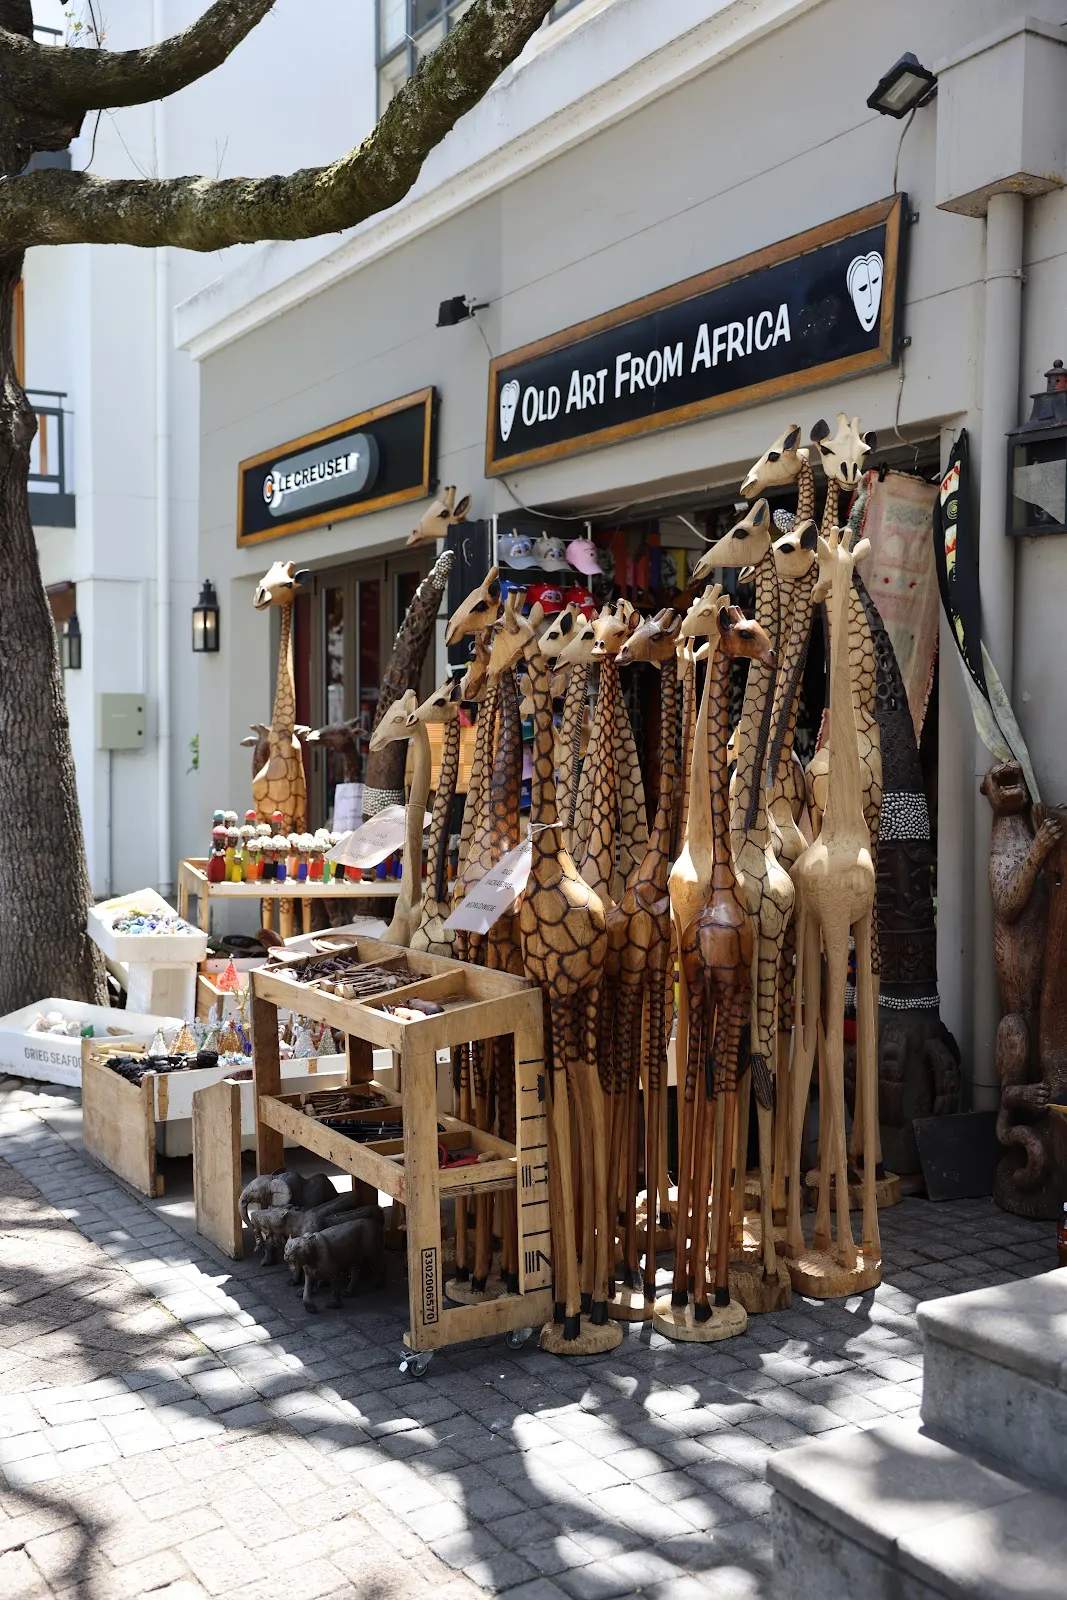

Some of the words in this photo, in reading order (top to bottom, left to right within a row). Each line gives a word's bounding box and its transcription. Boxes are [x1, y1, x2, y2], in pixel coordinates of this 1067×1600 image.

[521, 385, 561, 427] OLD
[565, 369, 609, 414] ART
[614, 342, 684, 399] FROM
[690, 303, 792, 373] AFRICA
[279, 474, 292, 492] LE
[294, 453, 351, 486] CREUSET
[425, 1252, 435, 1320] 3302006570
